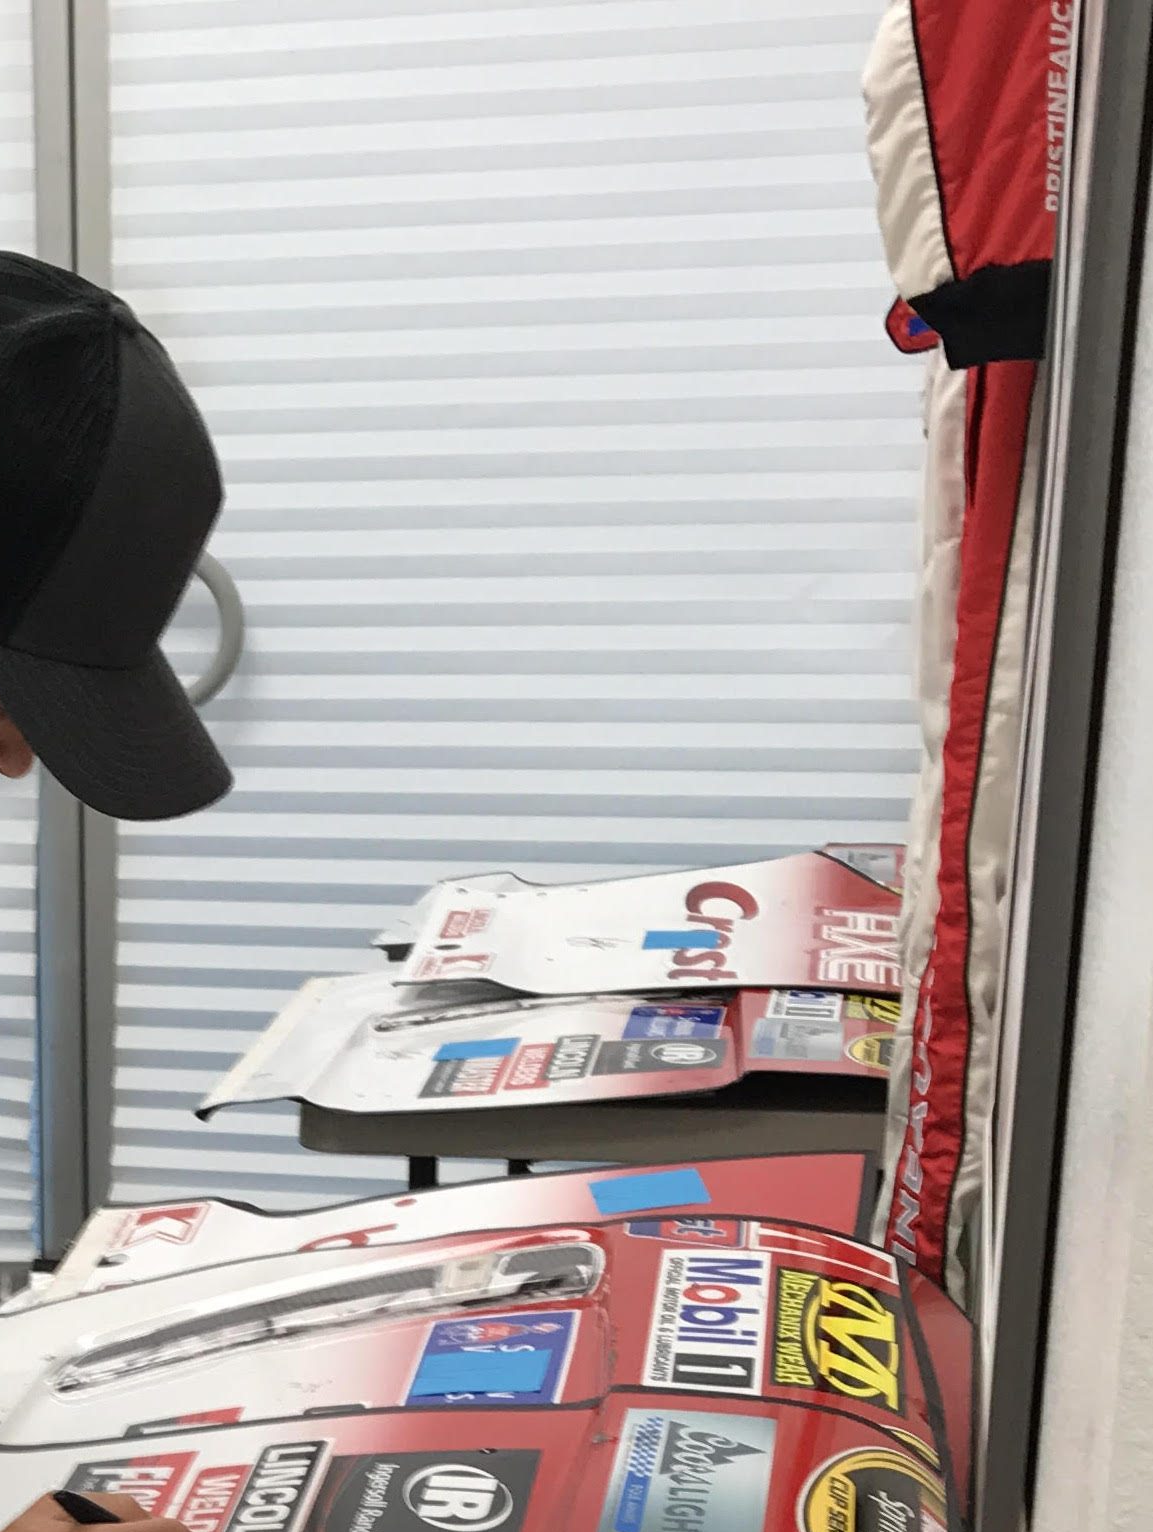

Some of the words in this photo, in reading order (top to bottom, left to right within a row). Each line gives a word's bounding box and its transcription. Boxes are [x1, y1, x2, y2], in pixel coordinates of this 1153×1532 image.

[668, 880, 759, 980] Crst
[677, 1257, 764, 1346] Mobil
[776, 1269, 819, 1341] MECHANIX
[774, 1341, 814, 1386] WEAR
[360, 1462, 401, 1508] Ingersoll
[419, 1475, 500, 1520] IR
[831, 1476, 850, 1510] CUP
